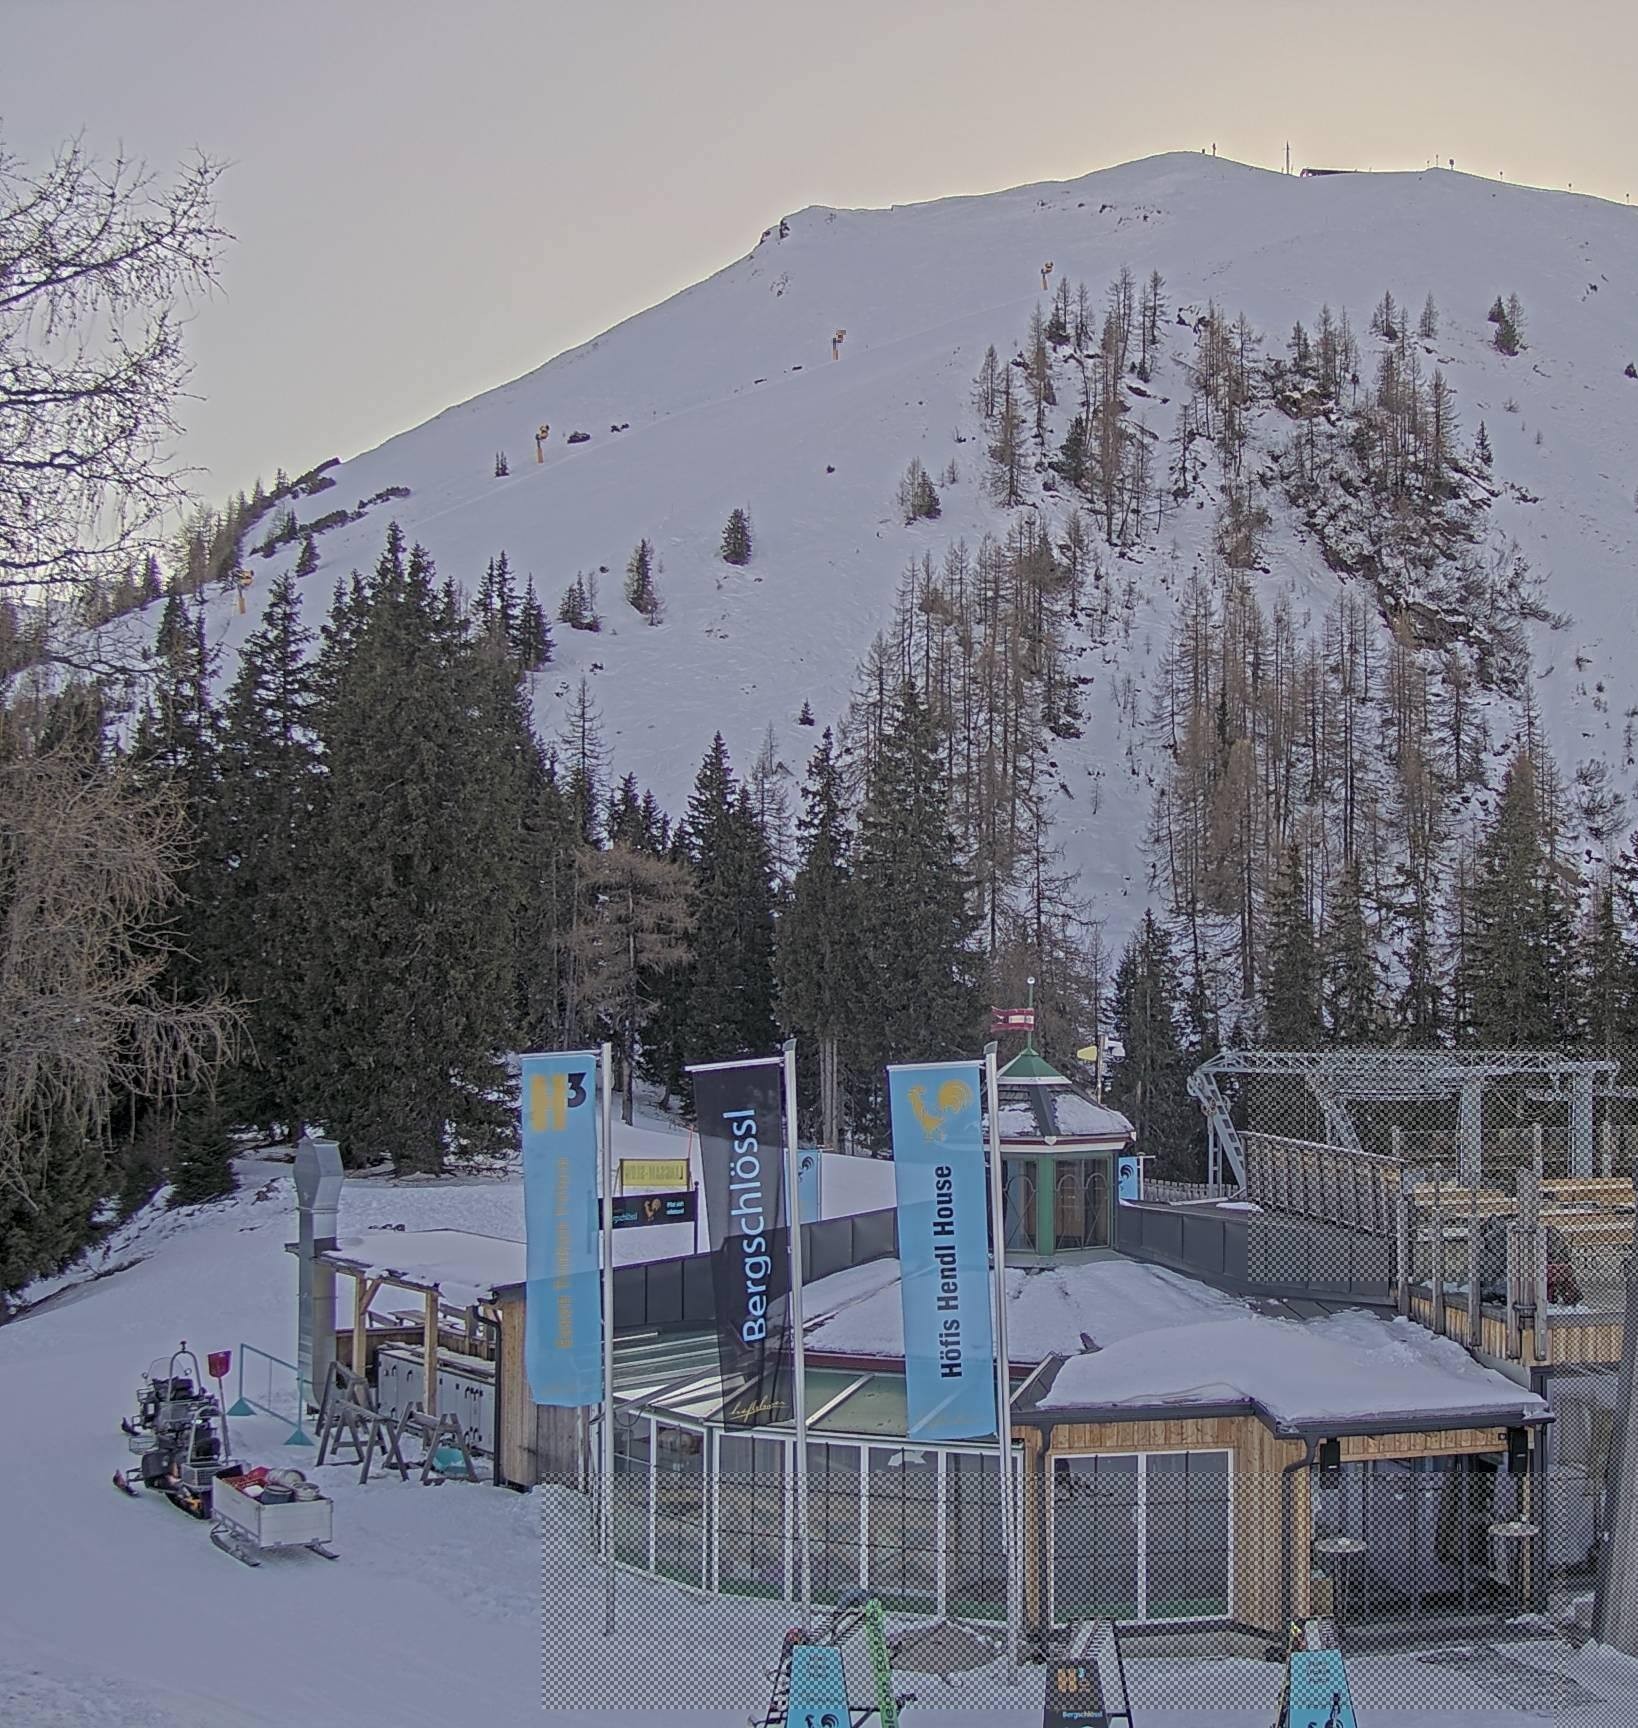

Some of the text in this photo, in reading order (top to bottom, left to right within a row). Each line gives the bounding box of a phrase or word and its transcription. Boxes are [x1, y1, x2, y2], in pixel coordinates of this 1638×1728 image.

[722, 1108, 771, 1343] Bergschlössl
[933, 1165, 964, 1379] Höfis Hendl House
